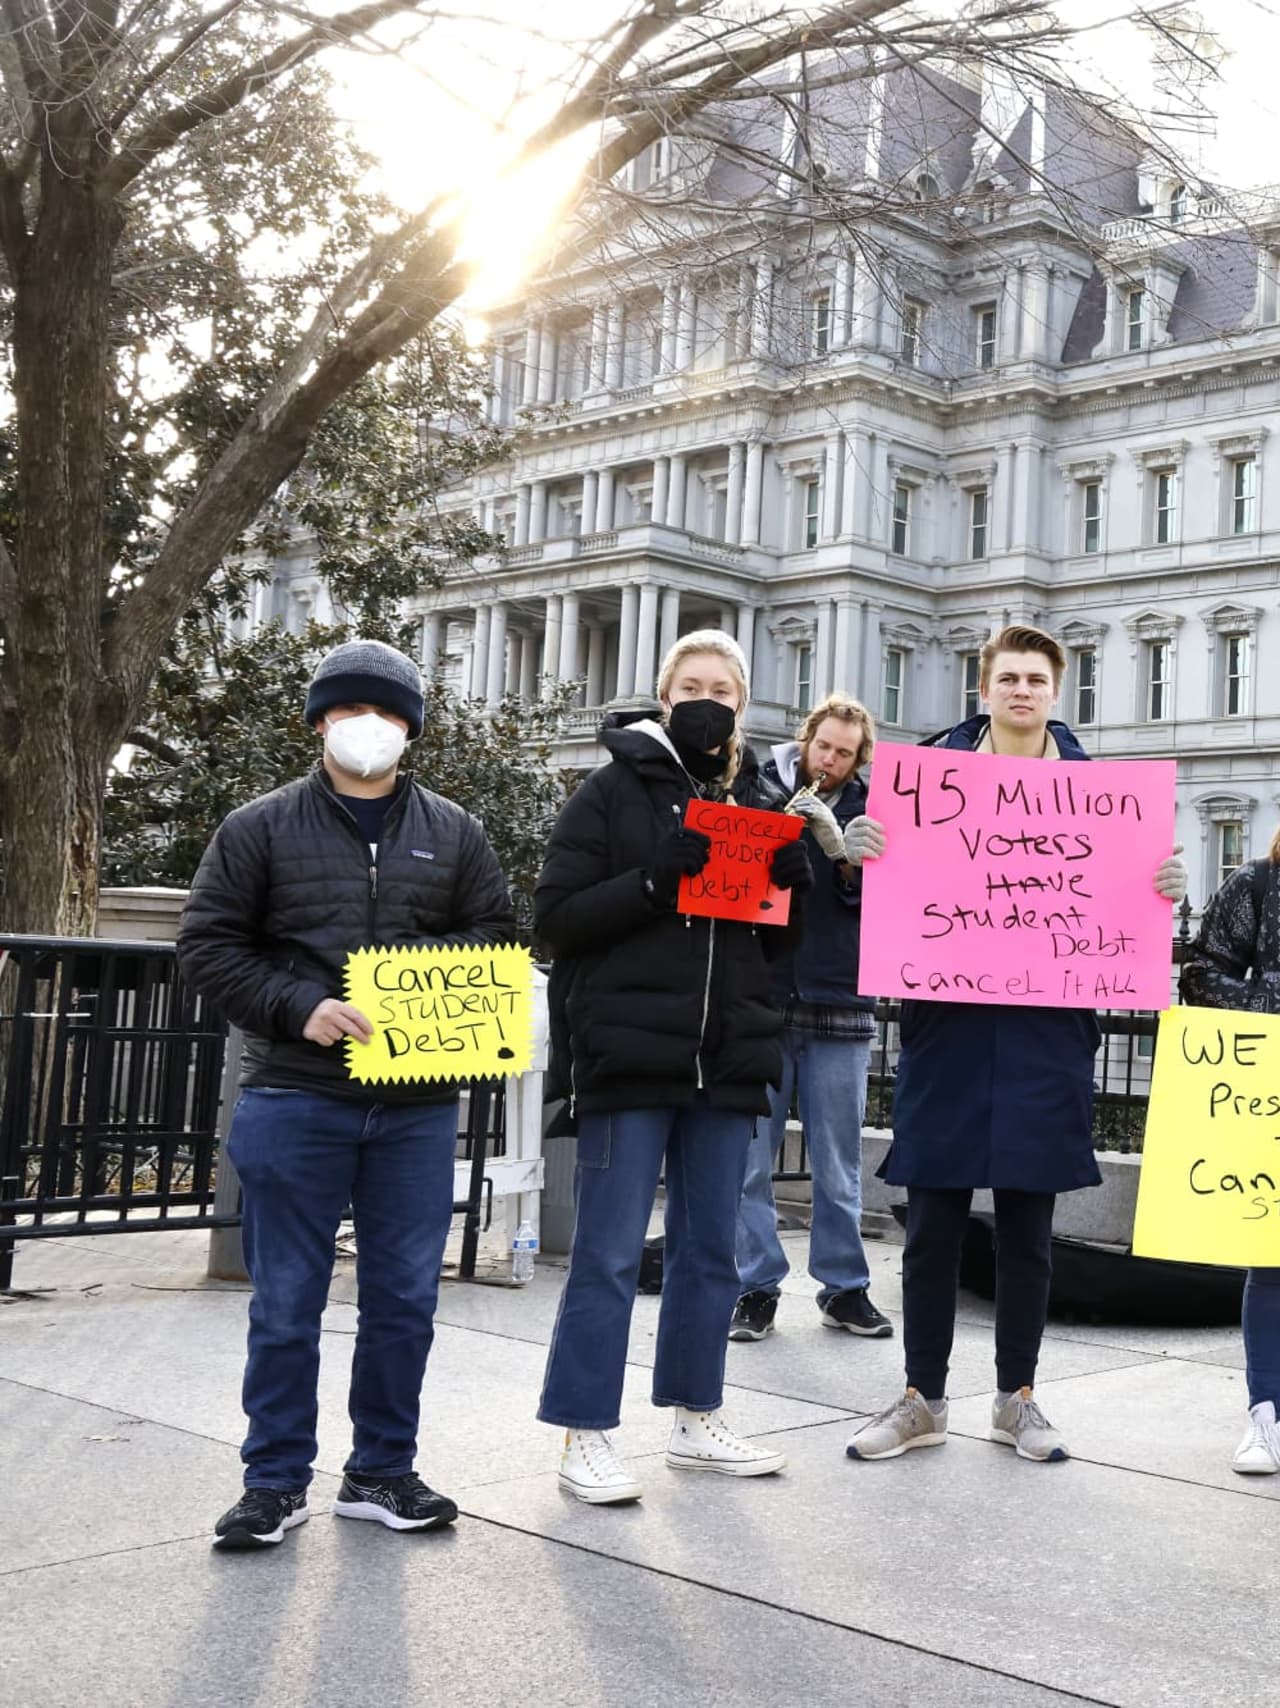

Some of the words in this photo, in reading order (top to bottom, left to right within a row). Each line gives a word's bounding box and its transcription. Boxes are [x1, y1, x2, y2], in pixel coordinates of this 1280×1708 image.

[893, 759, 966, 829] 45
[996, 775, 1142, 822] Million
[959, 826, 1093, 861] Voters
[921, 902, 1088, 938] Student
[1093, 972, 1137, 996] ALL
[1181, 1025, 1267, 1066] WE
